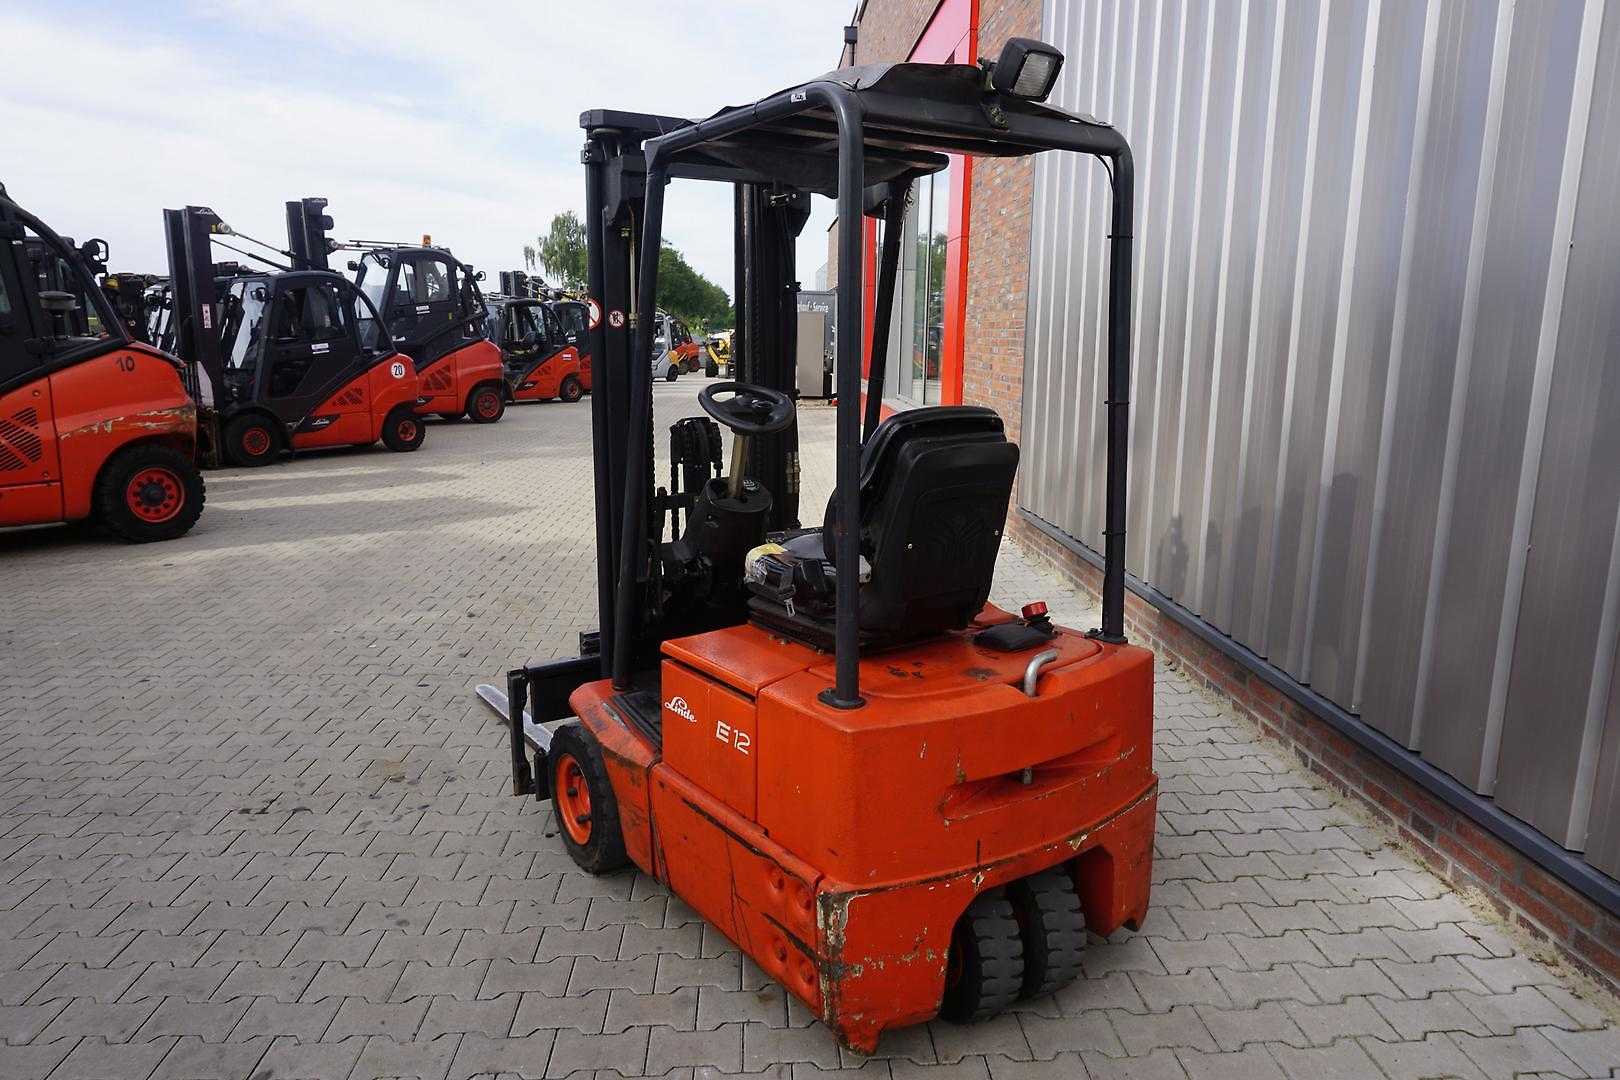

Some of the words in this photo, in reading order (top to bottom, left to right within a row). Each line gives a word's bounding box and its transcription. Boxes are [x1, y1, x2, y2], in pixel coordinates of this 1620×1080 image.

[115, 355, 135, 372] 10
[393, 364, 403, 376] 20
[664, 696, 697, 723] Linde
